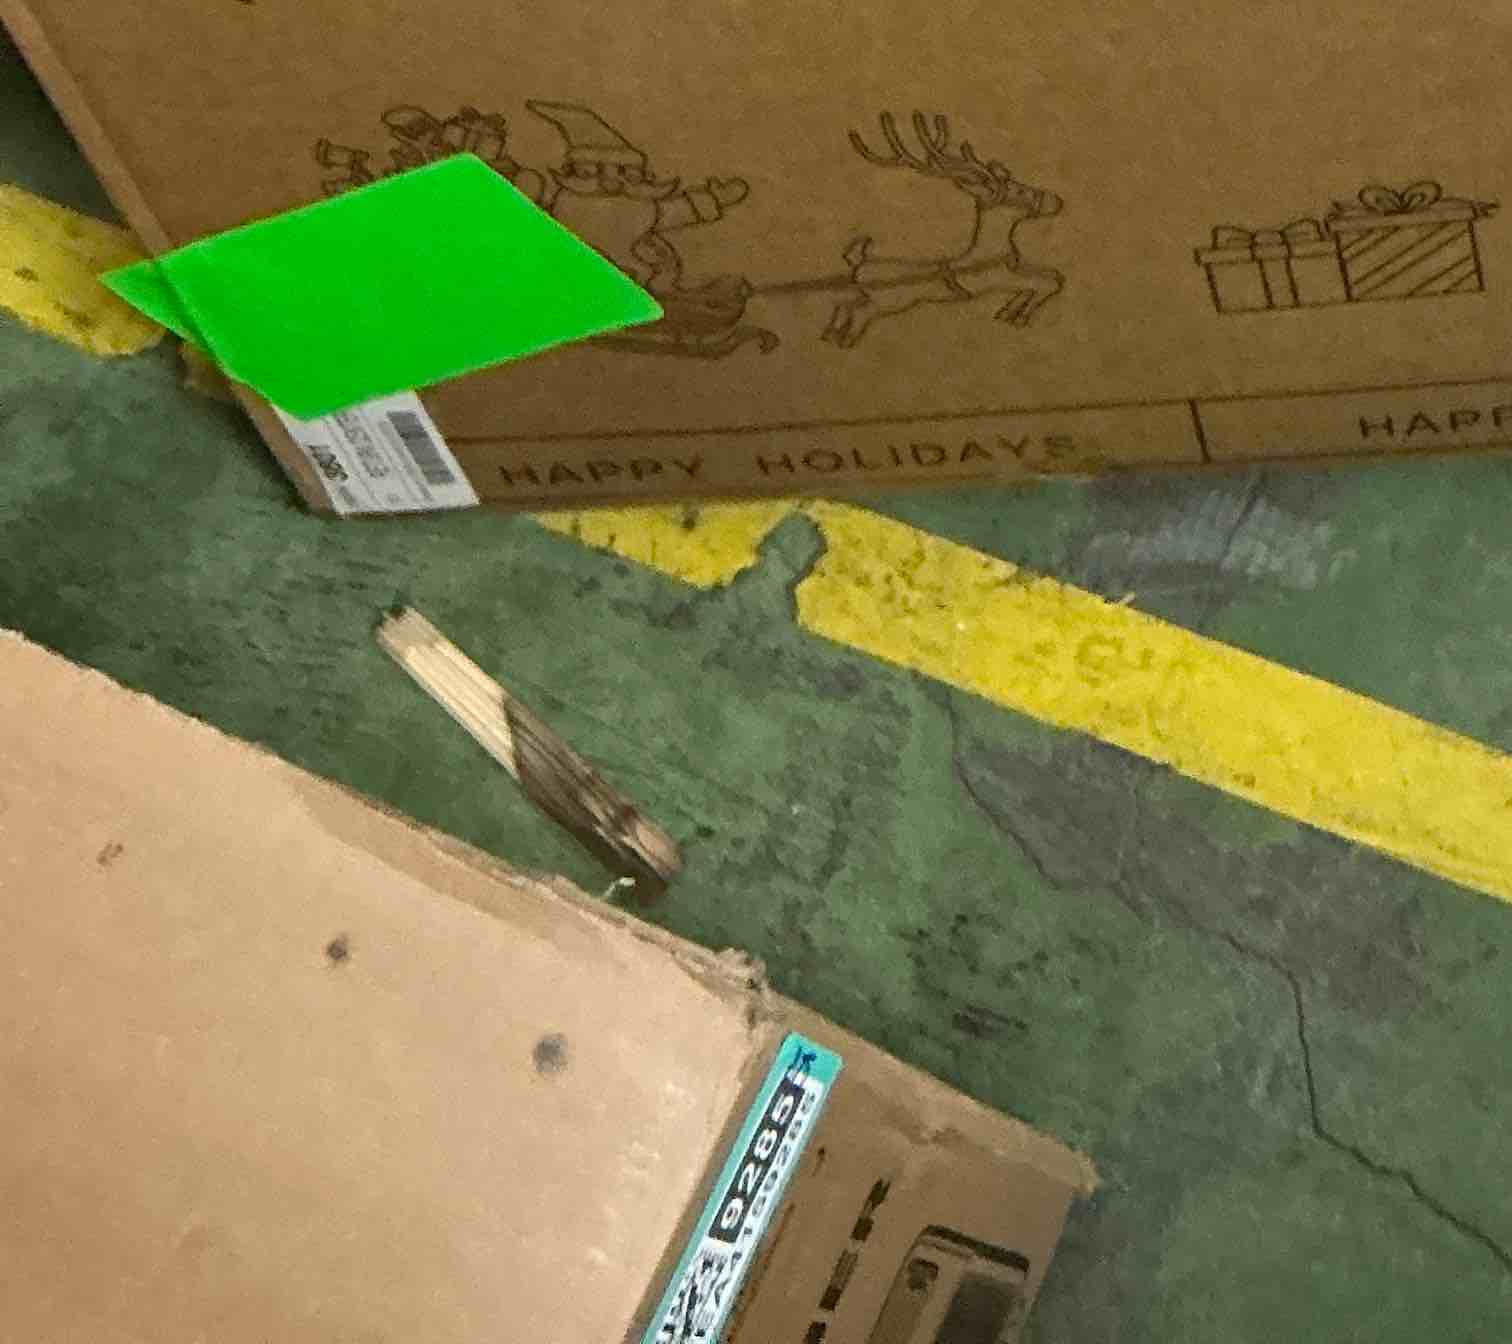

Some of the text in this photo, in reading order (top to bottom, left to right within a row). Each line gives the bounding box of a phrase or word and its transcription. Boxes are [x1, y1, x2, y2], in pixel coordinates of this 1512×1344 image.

[497, 432, 1079, 489] HAPPY HOLIDAYS
[718, 1092, 799, 1231] 9285
